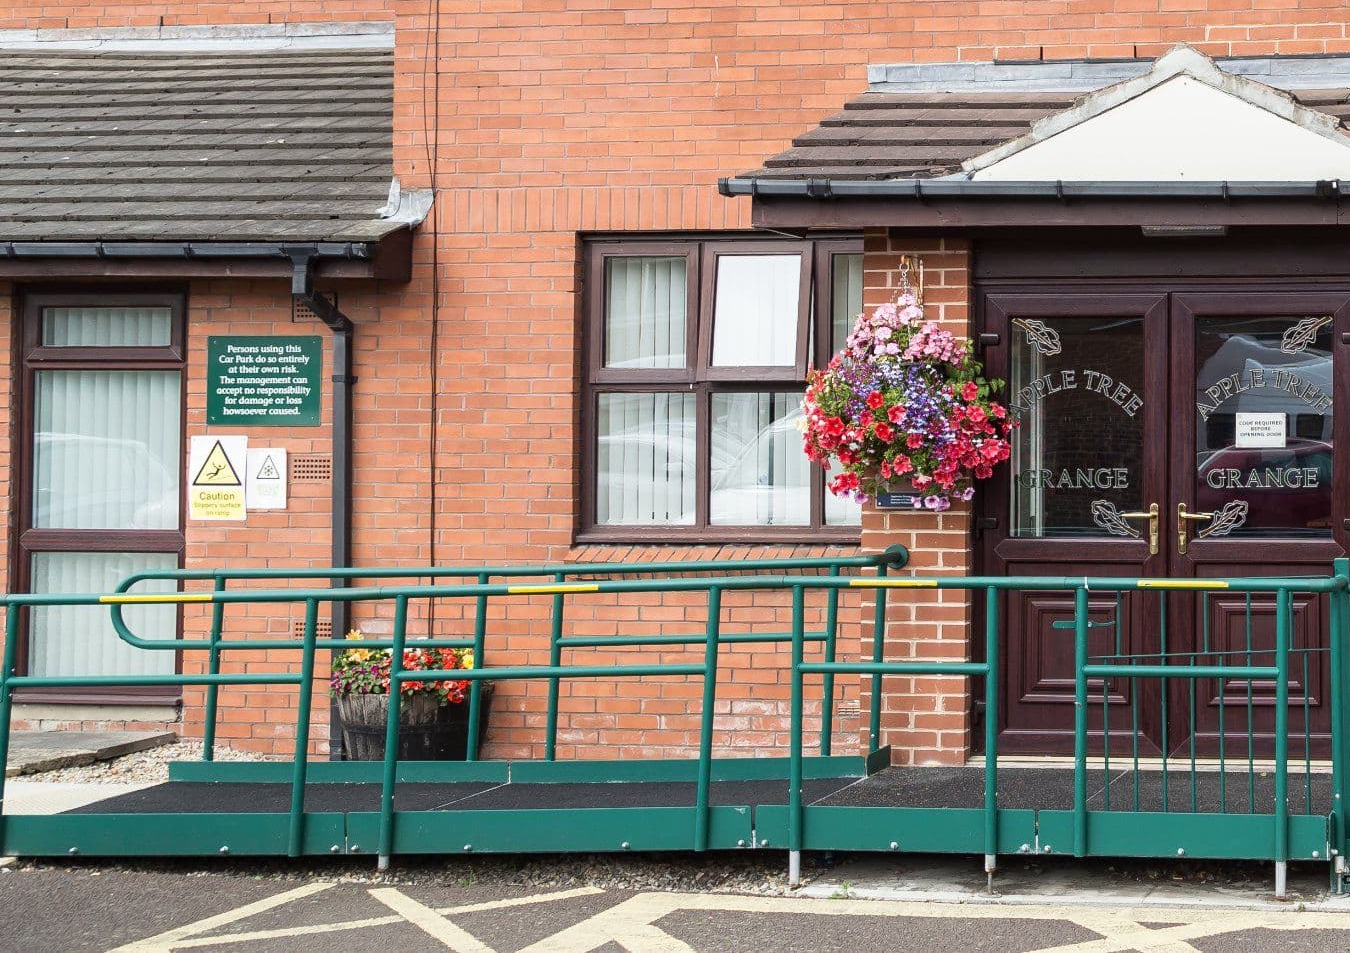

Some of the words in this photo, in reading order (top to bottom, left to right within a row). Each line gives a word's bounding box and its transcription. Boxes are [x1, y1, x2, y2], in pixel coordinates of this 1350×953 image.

[227, 345, 259, 353] Persons
[261, 345, 283, 355] using
[286, 344, 302, 353] this
[219, 355, 234, 363] Car
[235, 355, 254, 363] Park
[255, 355, 266, 363] do
[278, 355, 310, 365] entirely
[228, 366, 237, 374] at
[239, 365, 260, 374] their
[261, 366, 279, 374] own
[281, 365, 299, 374] risk.
[220, 375, 237, 384] The
[237, 376, 291, 386] management
[216, 387, 243, 396] accept
[256, 386, 311, 396] responsibility
[1009, 369, 1078, 419] APPLE
[1083, 369, 1144, 417] TREE
[1197, 368, 1266, 422] APPLE
[1271, 369, 1333, 416] TREE
[224, 396, 237, 405] for
[238, 396, 273, 407] damage
[286, 396, 302, 405] loss
[223, 407, 267, 415] howsoever
[268, 406, 301, 415] caused.
[1020, 467, 1129, 489] GRANGE
[1206, 467, 1320, 489] GRANGE
[199, 491, 235, 501] Caution
